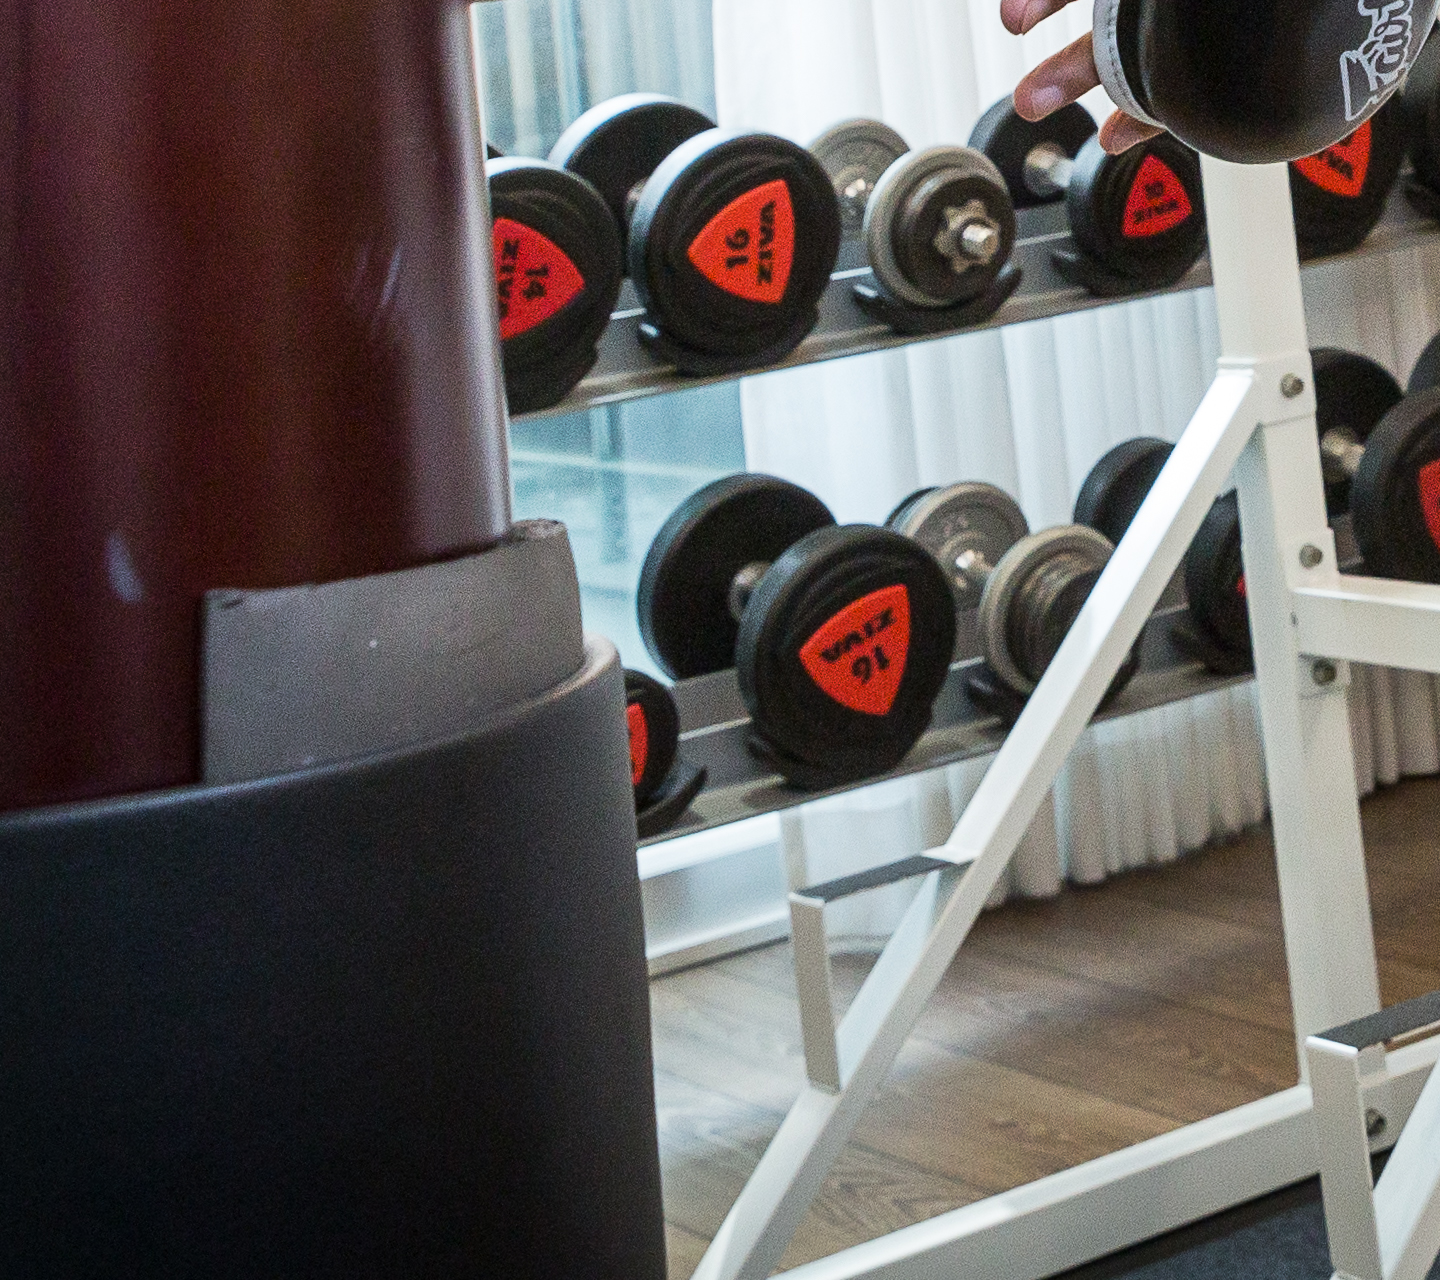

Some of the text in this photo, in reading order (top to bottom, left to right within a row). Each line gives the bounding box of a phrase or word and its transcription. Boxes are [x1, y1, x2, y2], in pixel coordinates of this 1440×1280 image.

[724, 227, 750, 270] 16
[757, 200, 777, 286] ZIVA
[522, 265, 550, 301] 14
[820, 606, 896, 663] ZIVA
[850, 644, 891, 683] 16
